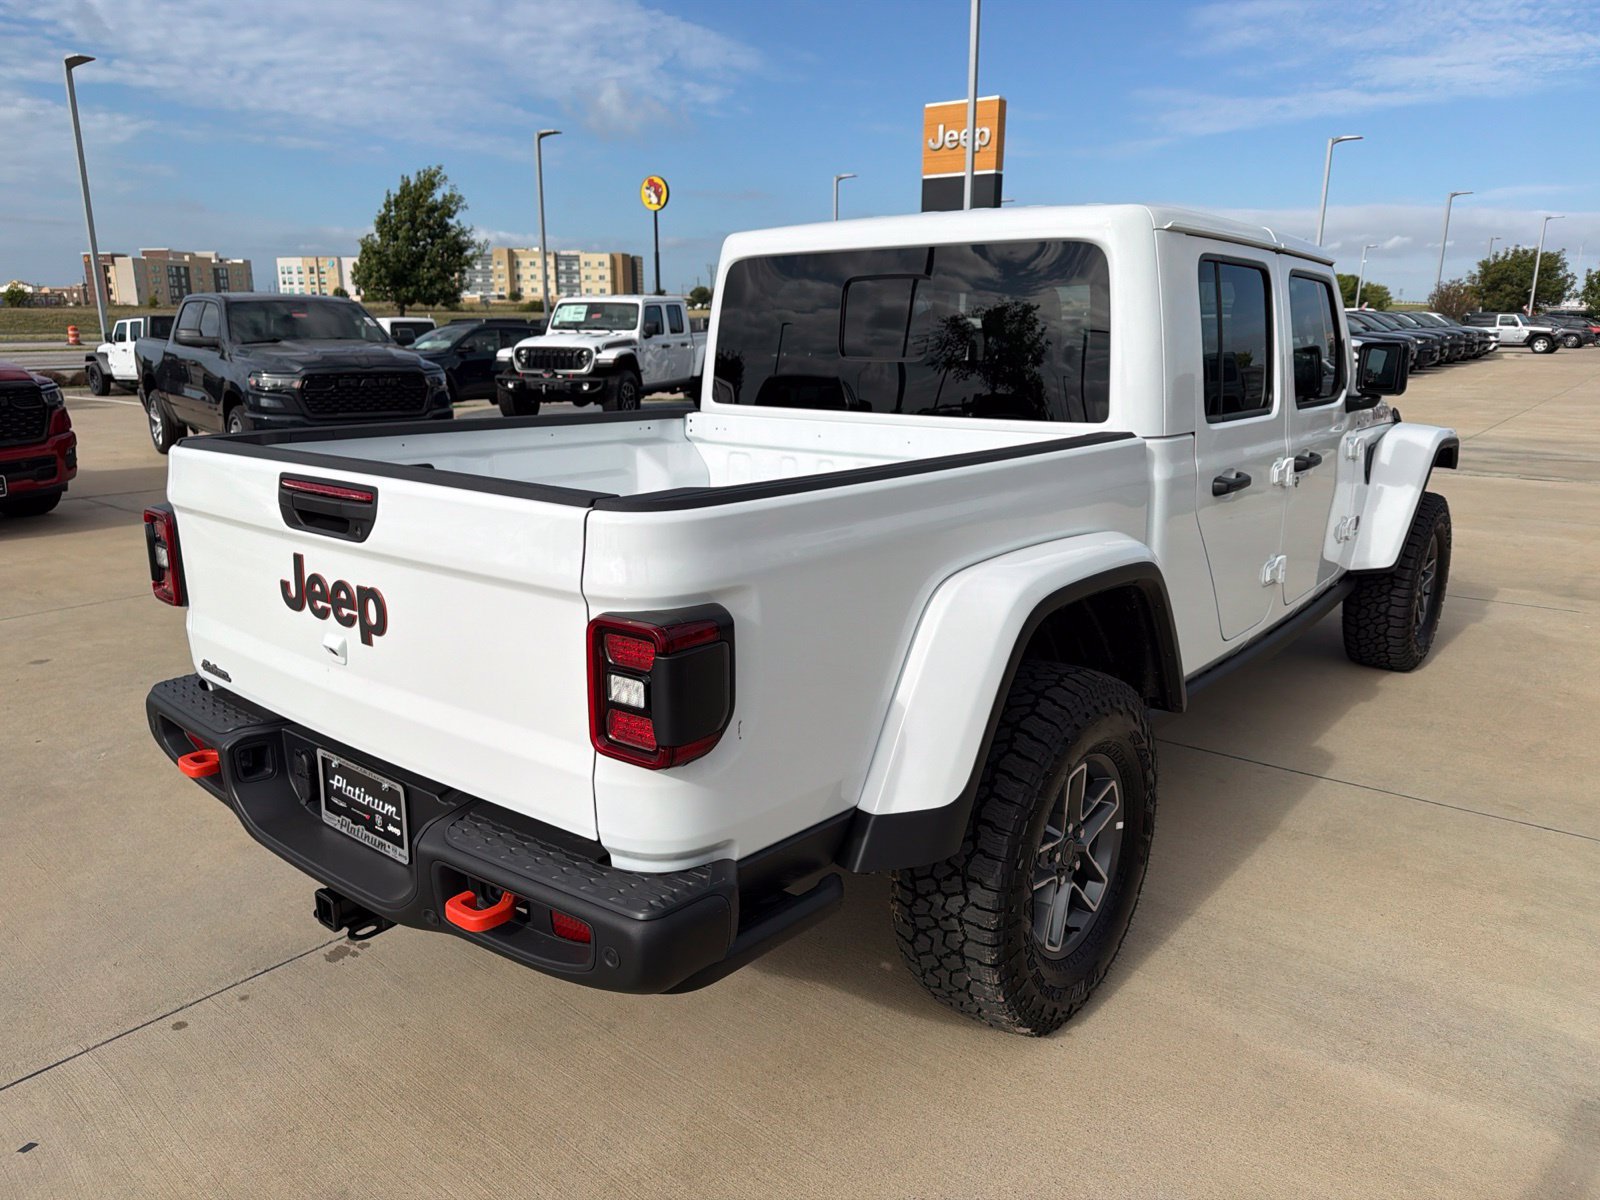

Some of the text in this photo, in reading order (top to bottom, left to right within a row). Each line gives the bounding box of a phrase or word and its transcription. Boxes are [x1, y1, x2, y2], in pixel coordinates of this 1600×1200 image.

[928, 124, 990, 151] Jeep
[280, 552, 388, 647] Jeep
[329, 775, 400, 820] Platinum
[340, 817, 390, 854] Platinum
